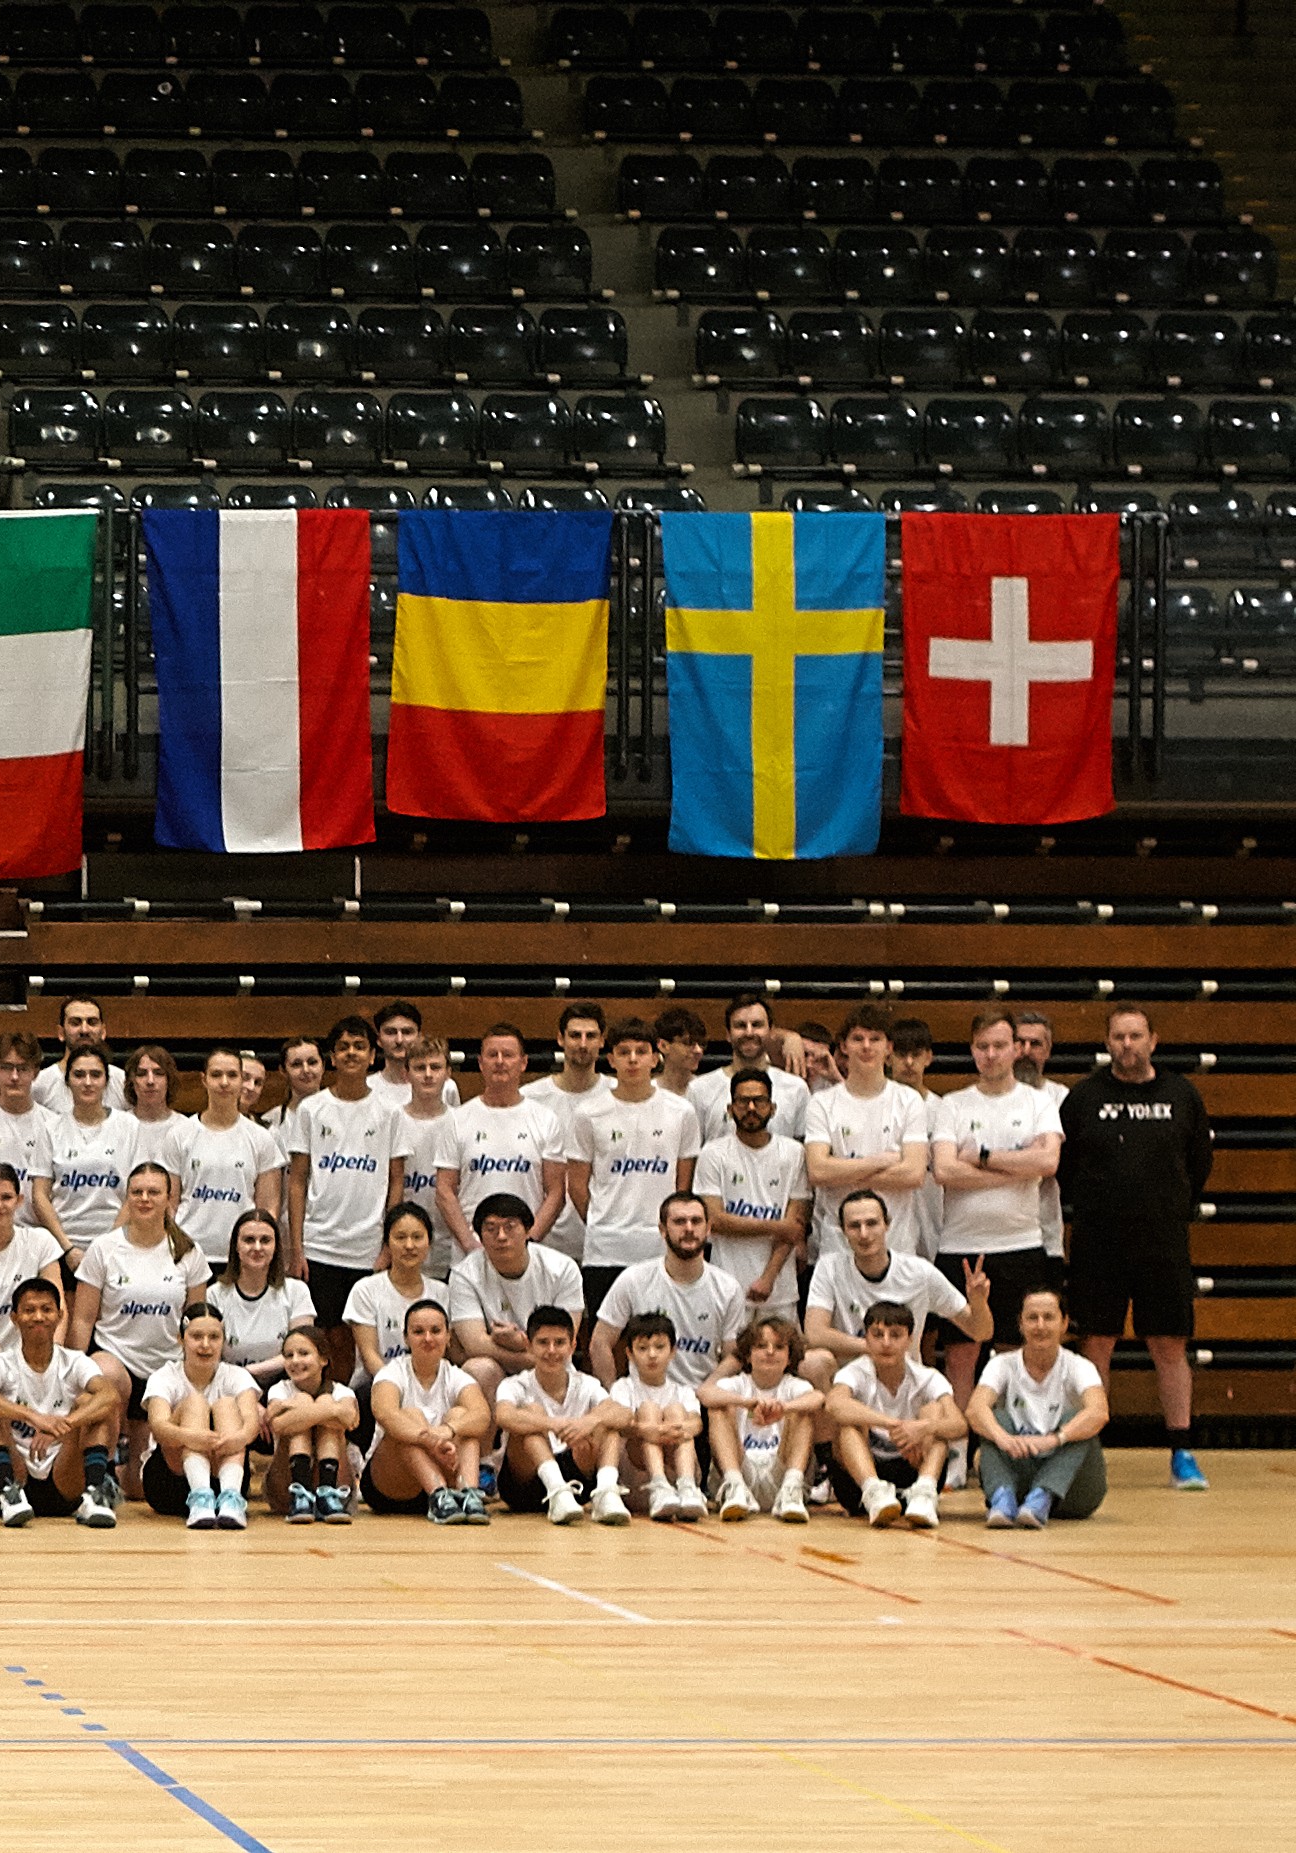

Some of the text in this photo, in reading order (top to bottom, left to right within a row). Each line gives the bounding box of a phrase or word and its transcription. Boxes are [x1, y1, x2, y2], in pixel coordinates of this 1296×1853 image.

[319, 1152, 377, 1172] alperia
[470, 1155, 531, 1176] alperia
[611, 1156, 668, 1176] aperia
[61, 1171, 120, 1191] alperia
[192, 1185, 241, 1202] alperia
[120, 1301, 171, 1319] alperia
